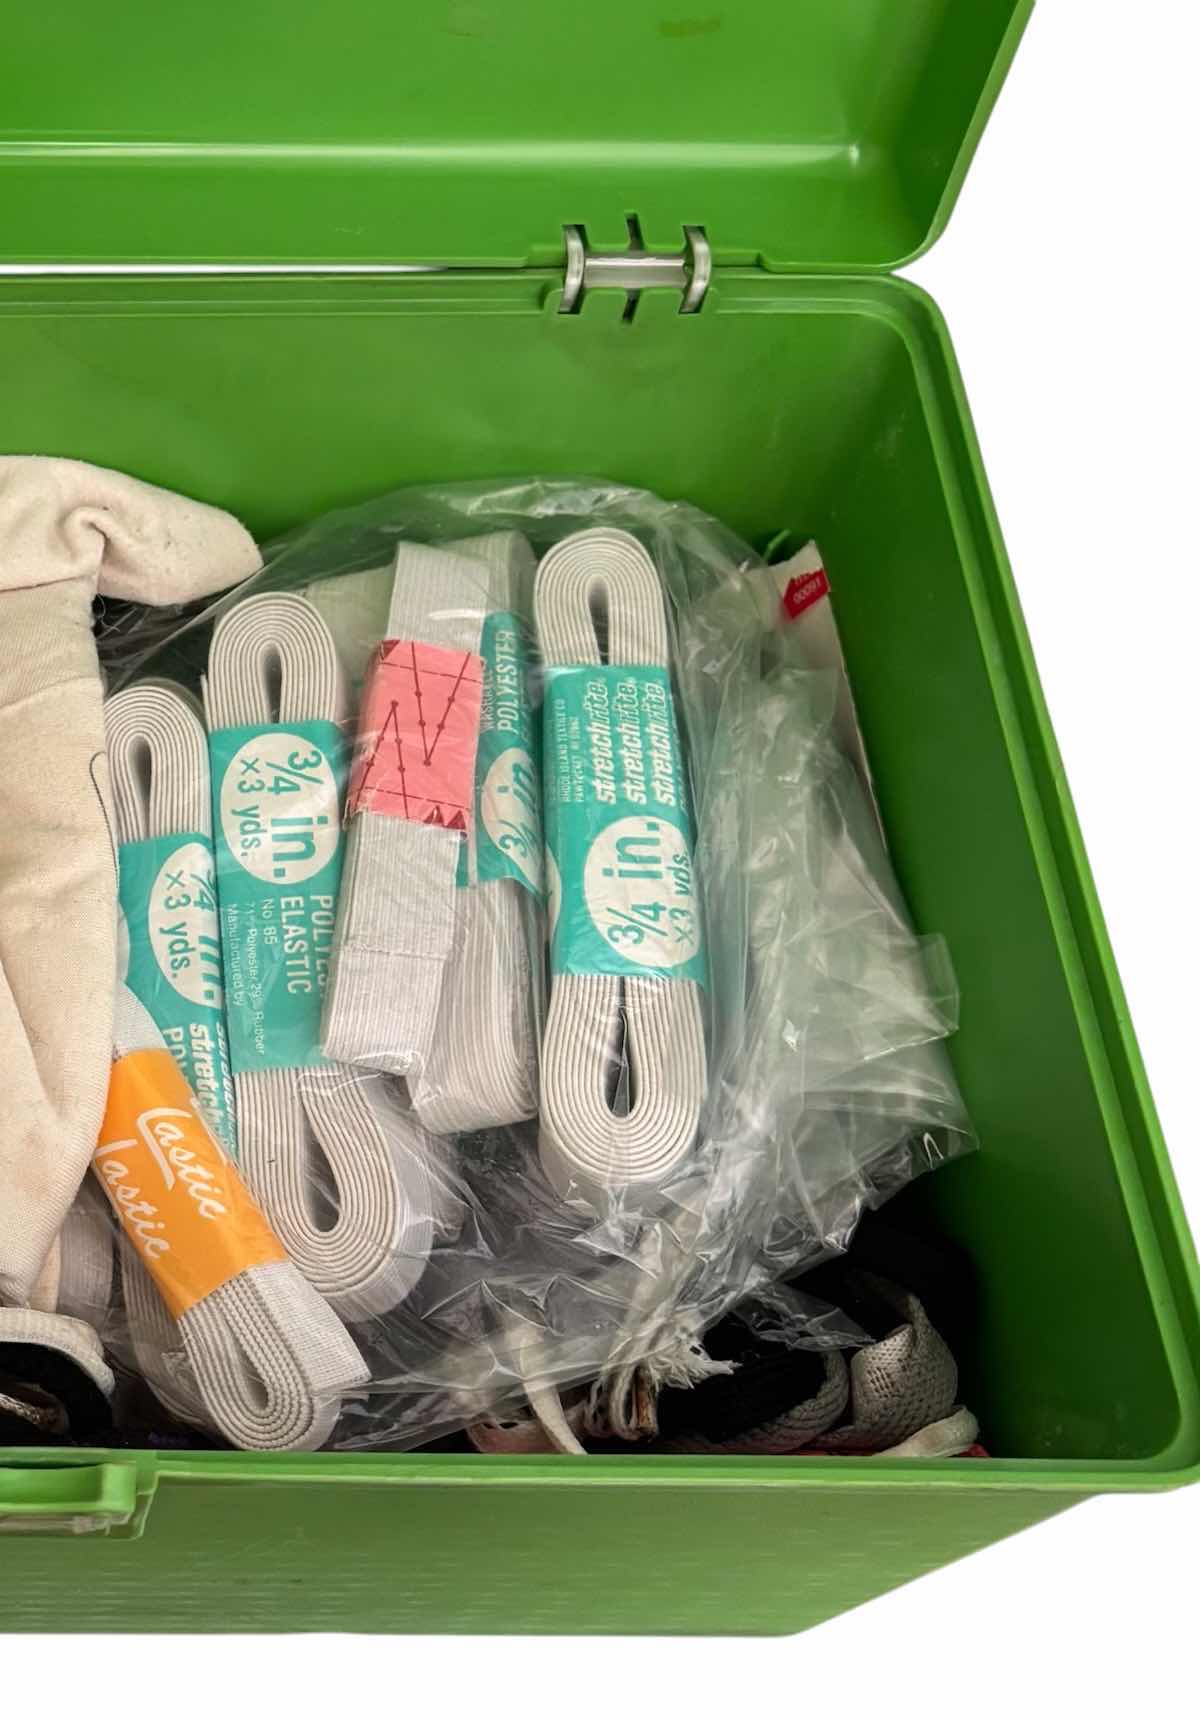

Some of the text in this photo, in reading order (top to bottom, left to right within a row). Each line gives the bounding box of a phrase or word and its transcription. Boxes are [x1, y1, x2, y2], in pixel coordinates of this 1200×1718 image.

[495, 630, 519, 735] POLYESTER
[230, 804, 267, 857] yds.
[266, 750, 329, 878] 3/4 in.
[602, 822, 663, 879] in.
[160, 921, 196, 978] yds.
[280, 896, 312, 994] ELASTIC
